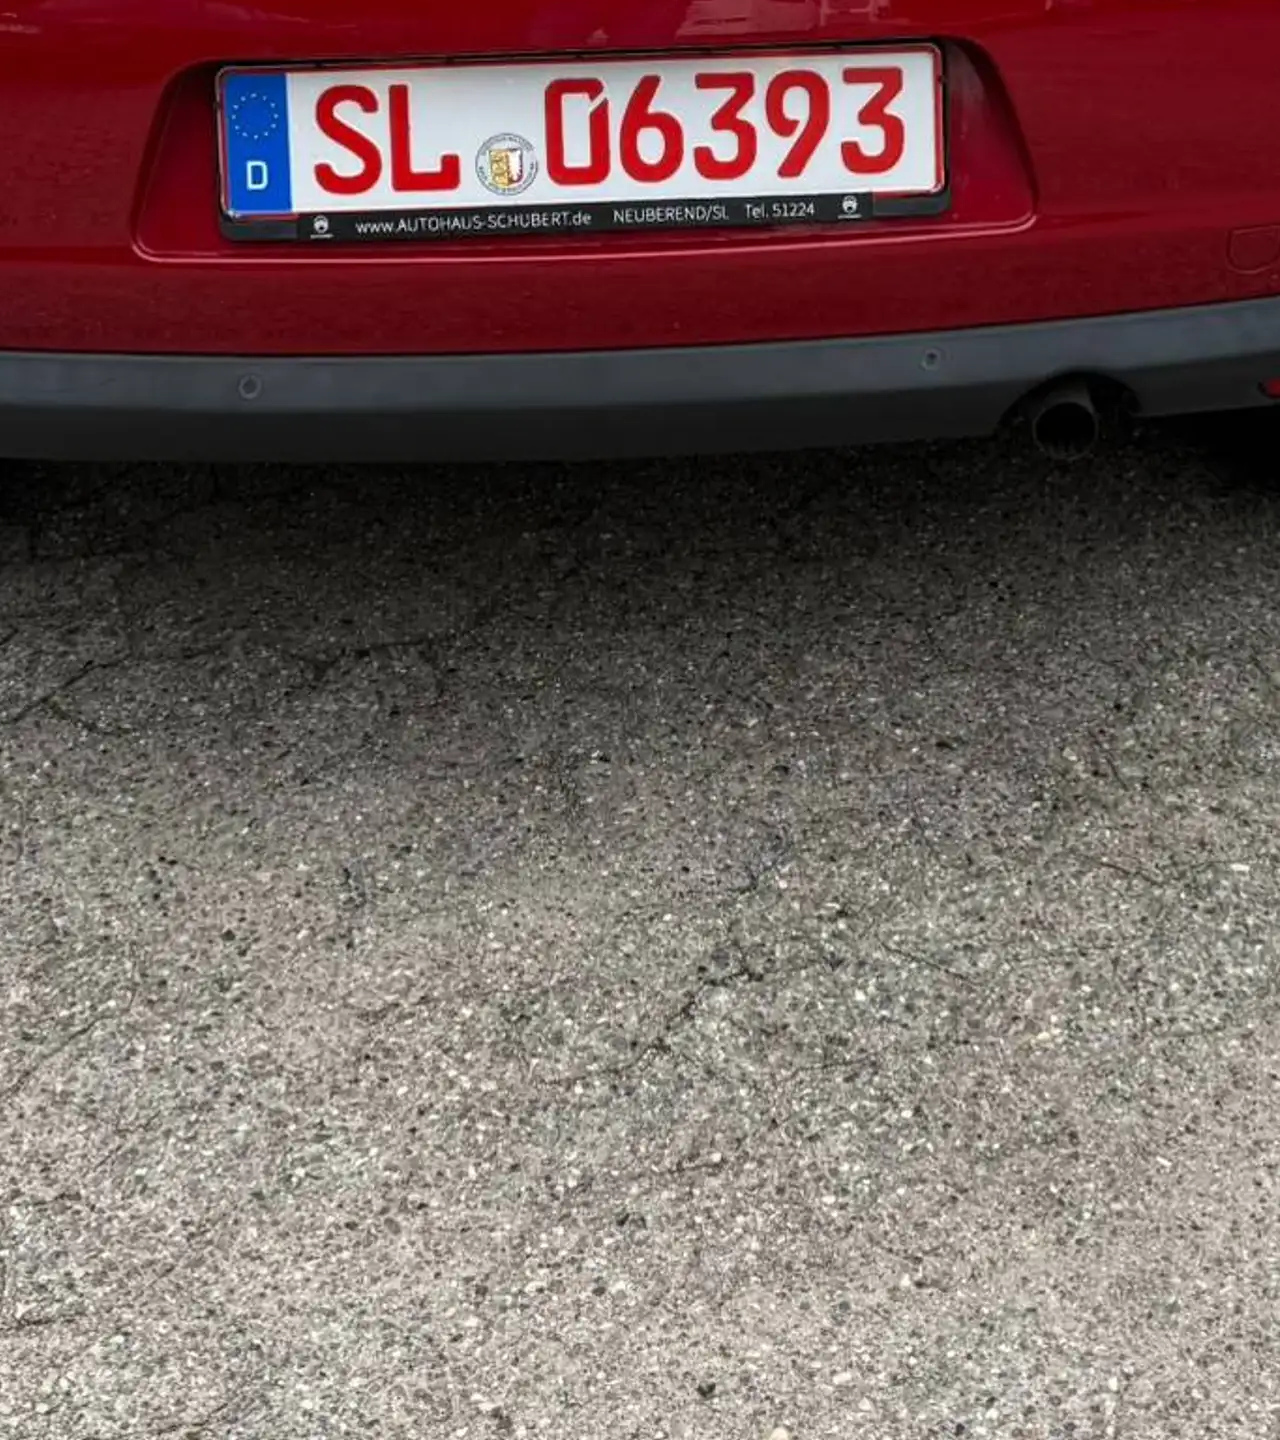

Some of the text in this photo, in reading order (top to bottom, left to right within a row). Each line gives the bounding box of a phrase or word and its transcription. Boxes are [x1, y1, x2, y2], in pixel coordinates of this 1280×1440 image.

[314, 84, 461, 196] SL
[544, 66, 905, 187] 06393
[246, 160, 268, 191] D
[355, 202, 815, 234] www.AUTOHAUS-SCHUBERT.de NEUBEREND/SL Tel. 51224
